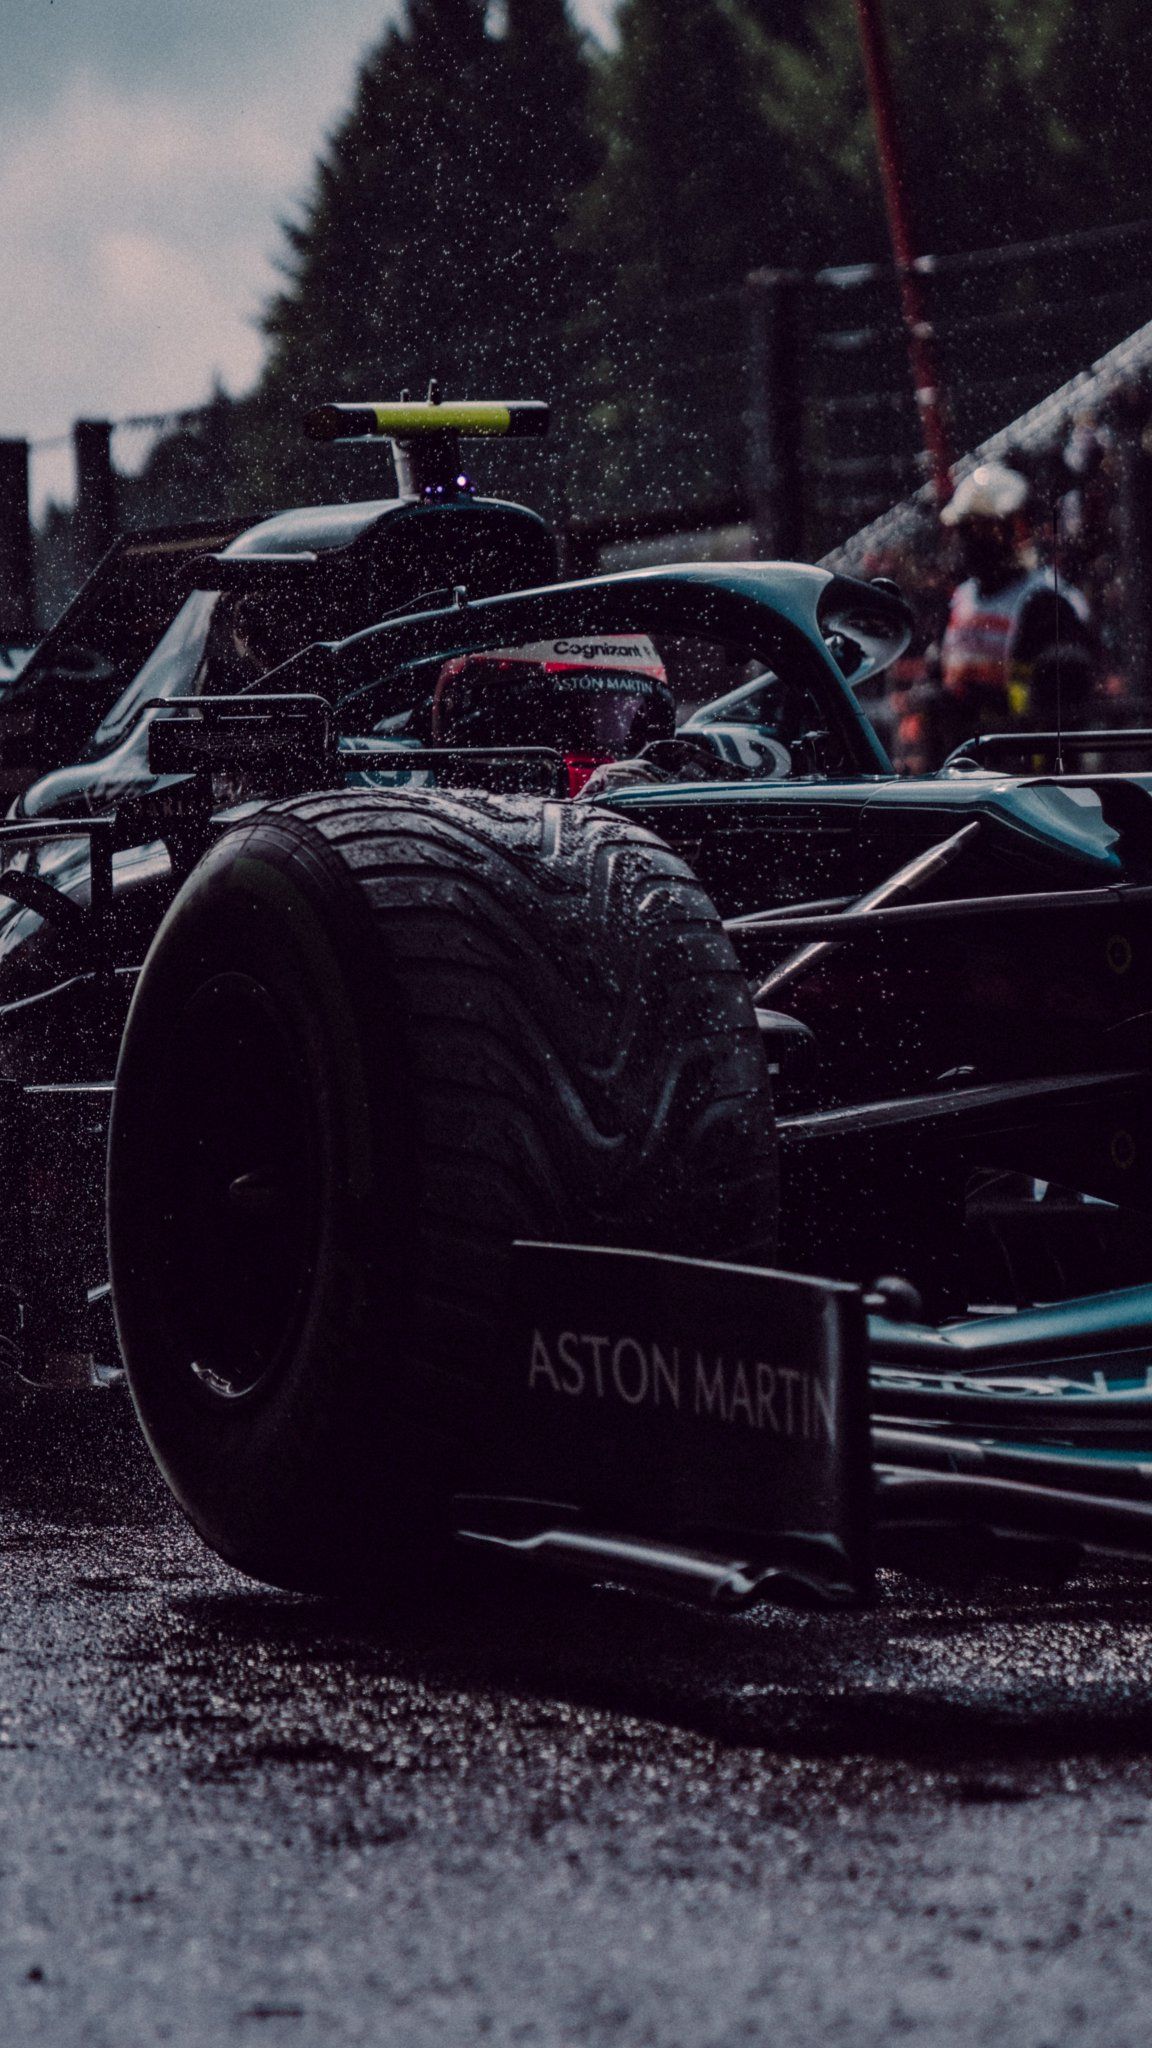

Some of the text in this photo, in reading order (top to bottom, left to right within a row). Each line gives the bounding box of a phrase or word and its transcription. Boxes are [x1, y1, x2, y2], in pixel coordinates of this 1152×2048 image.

[553, 641, 642, 659] Cognizant
[553, 675, 603, 691] ASTON
[606, 677, 653, 694] MARTIN
[528, 1328, 837, 1447] ASTON MARTIN
